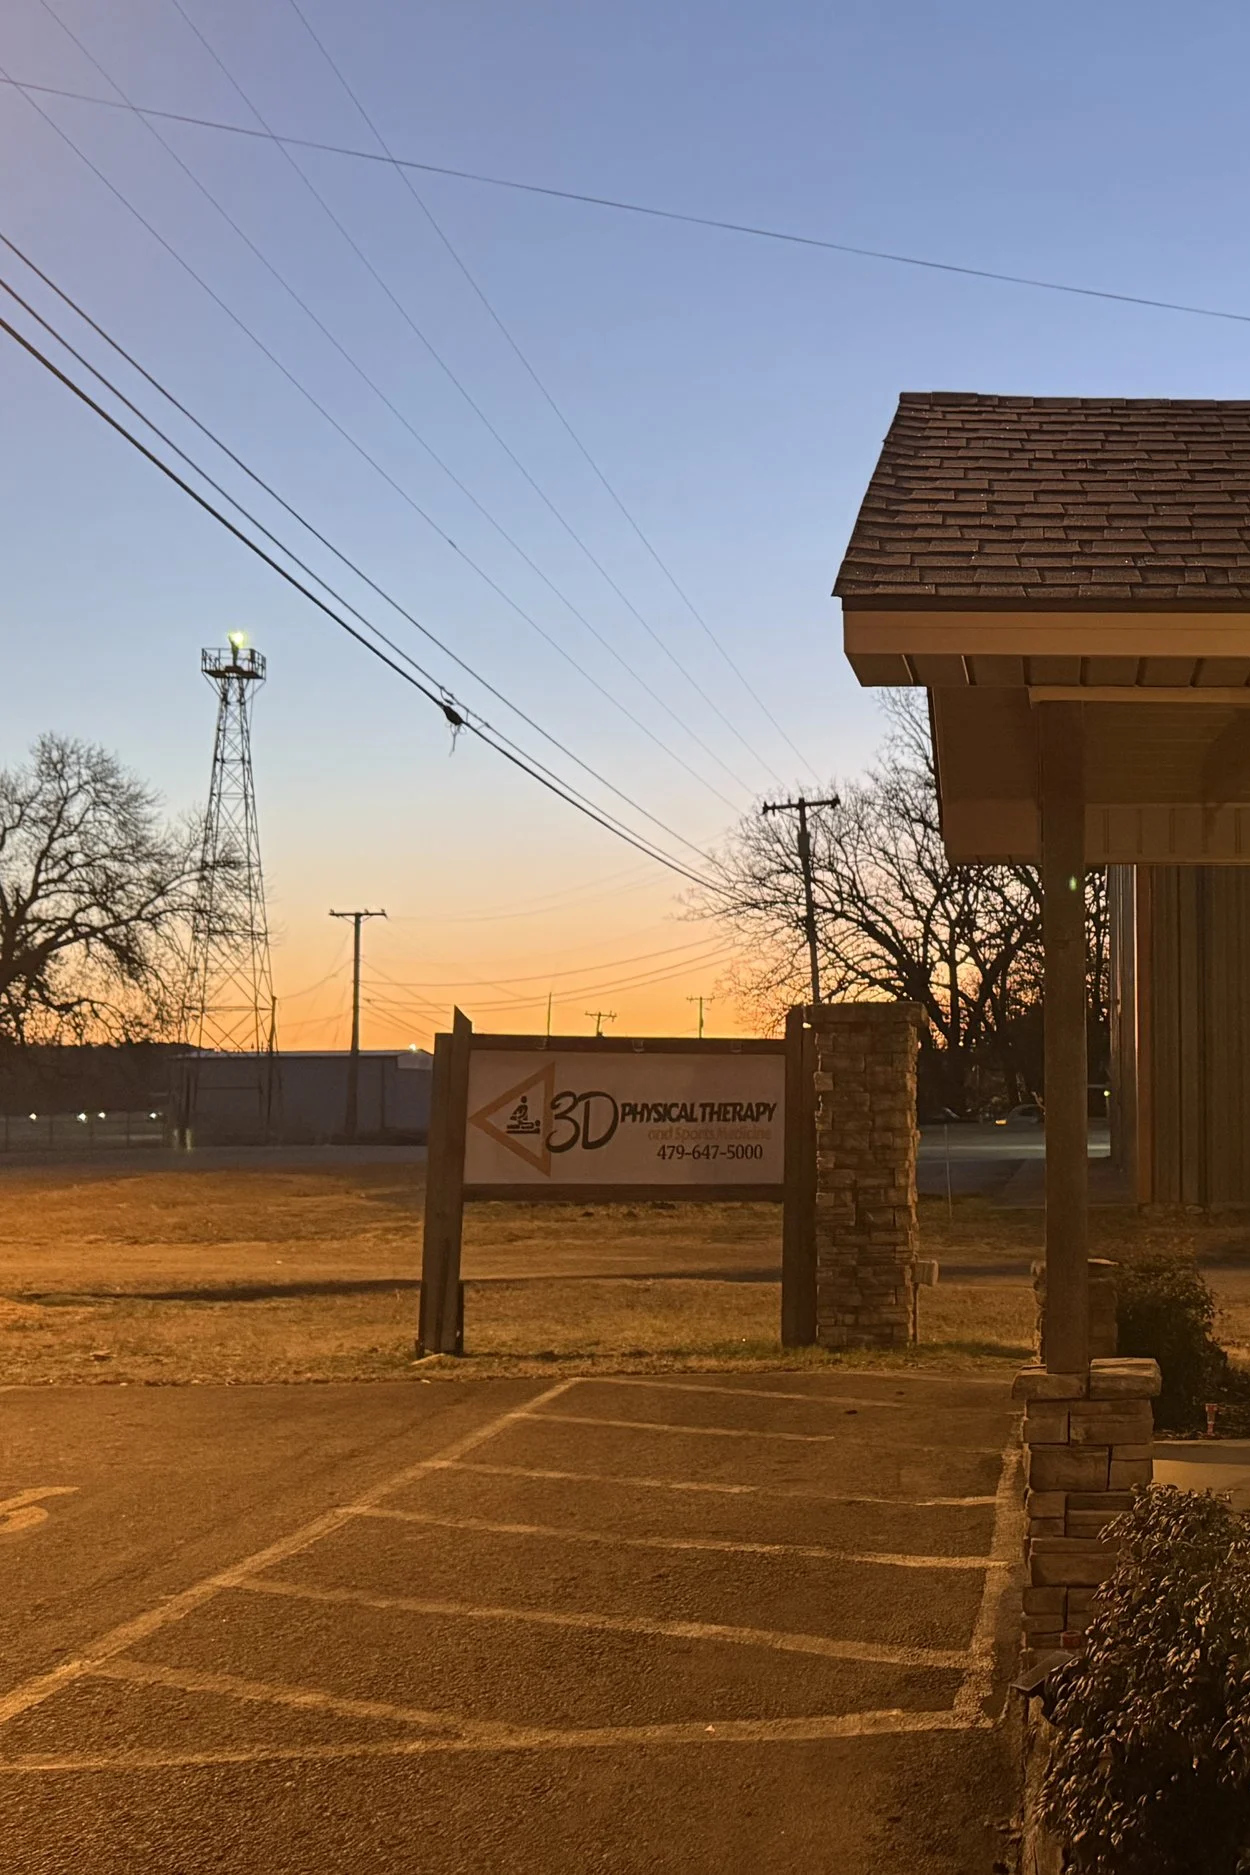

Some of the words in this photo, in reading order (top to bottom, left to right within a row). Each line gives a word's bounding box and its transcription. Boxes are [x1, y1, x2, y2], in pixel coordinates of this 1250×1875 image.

[545, 1090, 620, 1154] 3D
[620, 1102, 698, 1123] PHYSICAL
[699, 1102, 777, 1123] THERAPY
[648, 1126, 673, 1141] and
[657, 1144, 763, 1160] 479-647-5000
